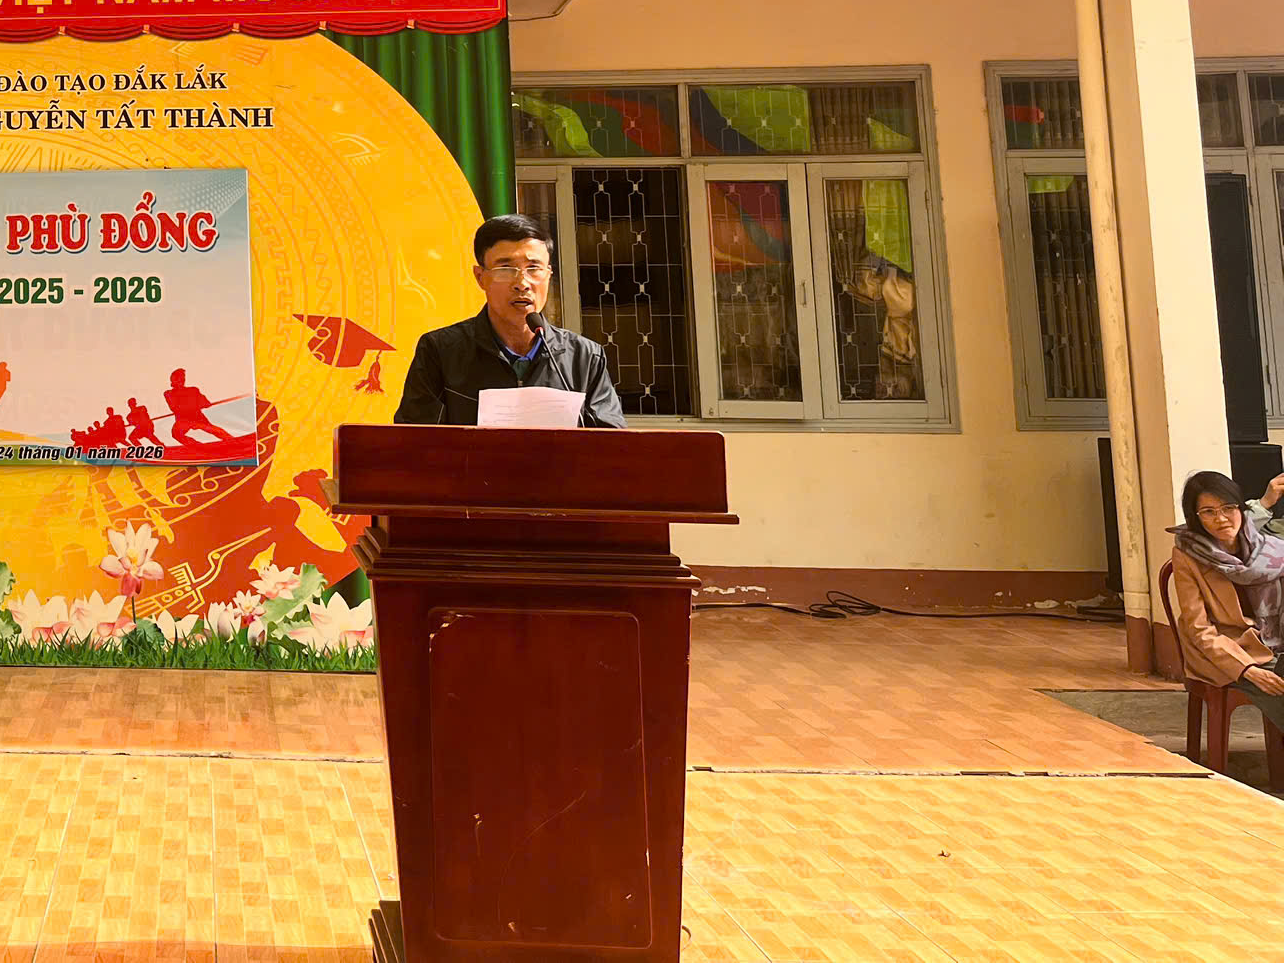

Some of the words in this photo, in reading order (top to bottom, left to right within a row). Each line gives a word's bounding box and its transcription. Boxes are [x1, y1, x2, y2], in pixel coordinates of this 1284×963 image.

[54, 73, 106, 95] TẠO
[113, 64, 167, 91] ĐẮK
[174, 63, 228, 90] LẮK
[95, 99, 156, 129] TẤT
[163, 101, 274, 128] THÀNH
[5, 202, 91, 254] PHÙ
[99, 190, 219, 252] ĐỔNG
[73, 288, 84, 296] -
[93, 275, 162, 304] 2026
[18, 445, 61, 461] tháng
[65, 445, 83, 460] 01
[88, 444, 121, 459] năm
[125, 445, 164, 460] 2026
